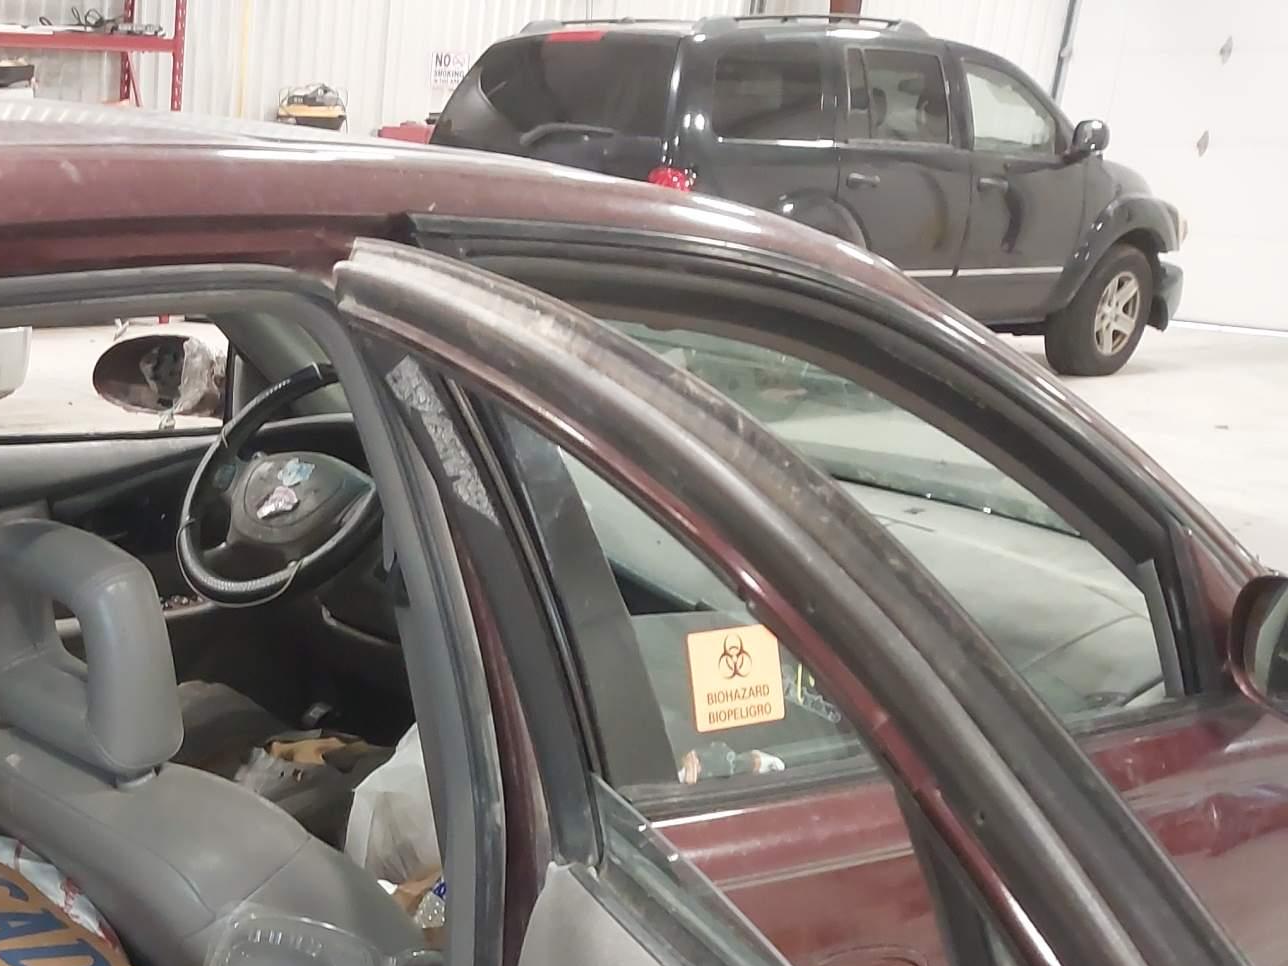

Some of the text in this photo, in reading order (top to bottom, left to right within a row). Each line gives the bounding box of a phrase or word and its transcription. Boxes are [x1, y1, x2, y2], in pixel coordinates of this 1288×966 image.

[435, 52, 451, 67] NO
[707, 684, 770, 705] BIOHAZARD
[708, 702, 772, 724] BIOPELIGRO
